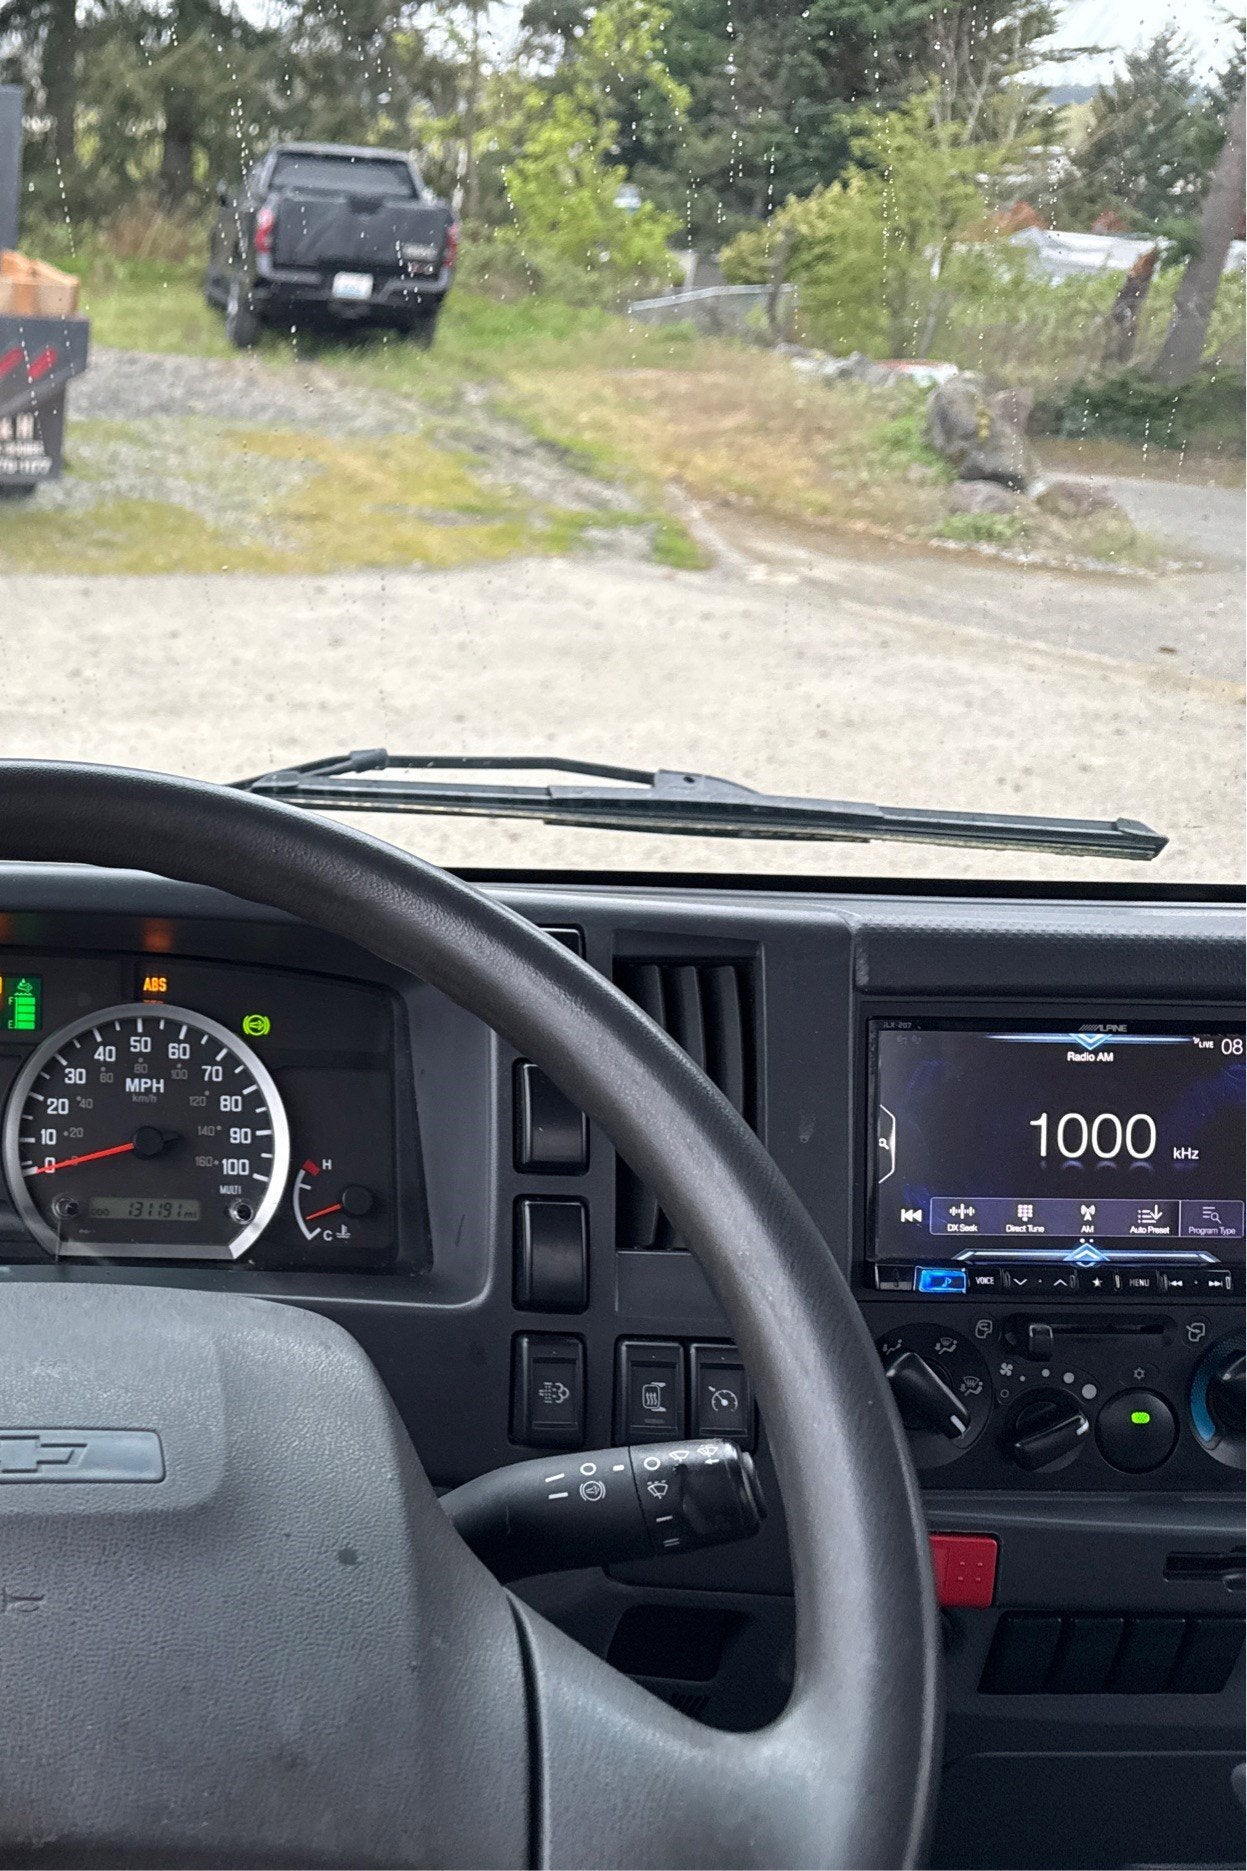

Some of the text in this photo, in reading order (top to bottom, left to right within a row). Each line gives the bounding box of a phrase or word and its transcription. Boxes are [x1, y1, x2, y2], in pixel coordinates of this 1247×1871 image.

[143, 977, 167, 992] ABS
[130, 1036, 151, 1052] 50
[168, 1043, 190, 1059] 60
[1221, 1038, 1243, 1055] 08
[94, 1046, 116, 1062] 40
[1067, 1051, 1114, 1062] Radio AM
[64, 1068, 86, 1084] 30
[201, 1065, 223, 1081] 70
[125, 1077, 164, 1093] MPH
[47, 1098, 69, 1114] 20
[219, 1095, 242, 1112] 80
[41, 1128, 57, 1145] 10
[229, 1127, 251, 1144] 90
[1029, 1113, 1157, 1160] 1000
[1173, 1147, 1200, 1160] kHz
[221, 1158, 250, 1175] 100
[322, 1159, 332, 1170] H
[219, 1185, 242, 1195] MULTI
[323, 1229, 333, 1241] C
[947, 1224, 978, 1232] DX Seek
[1006, 1225, 1045, 1233] Direct Tune
[1081, 1225, 1094, 1233] AM
[1130, 1226, 1170, 1234] Auto Preset
[1188, 1226, 1236, 1236] Program Type
[975, 1276, 994, 1285] VOICE
[1129, 1278, 1150, 1287] MENU
